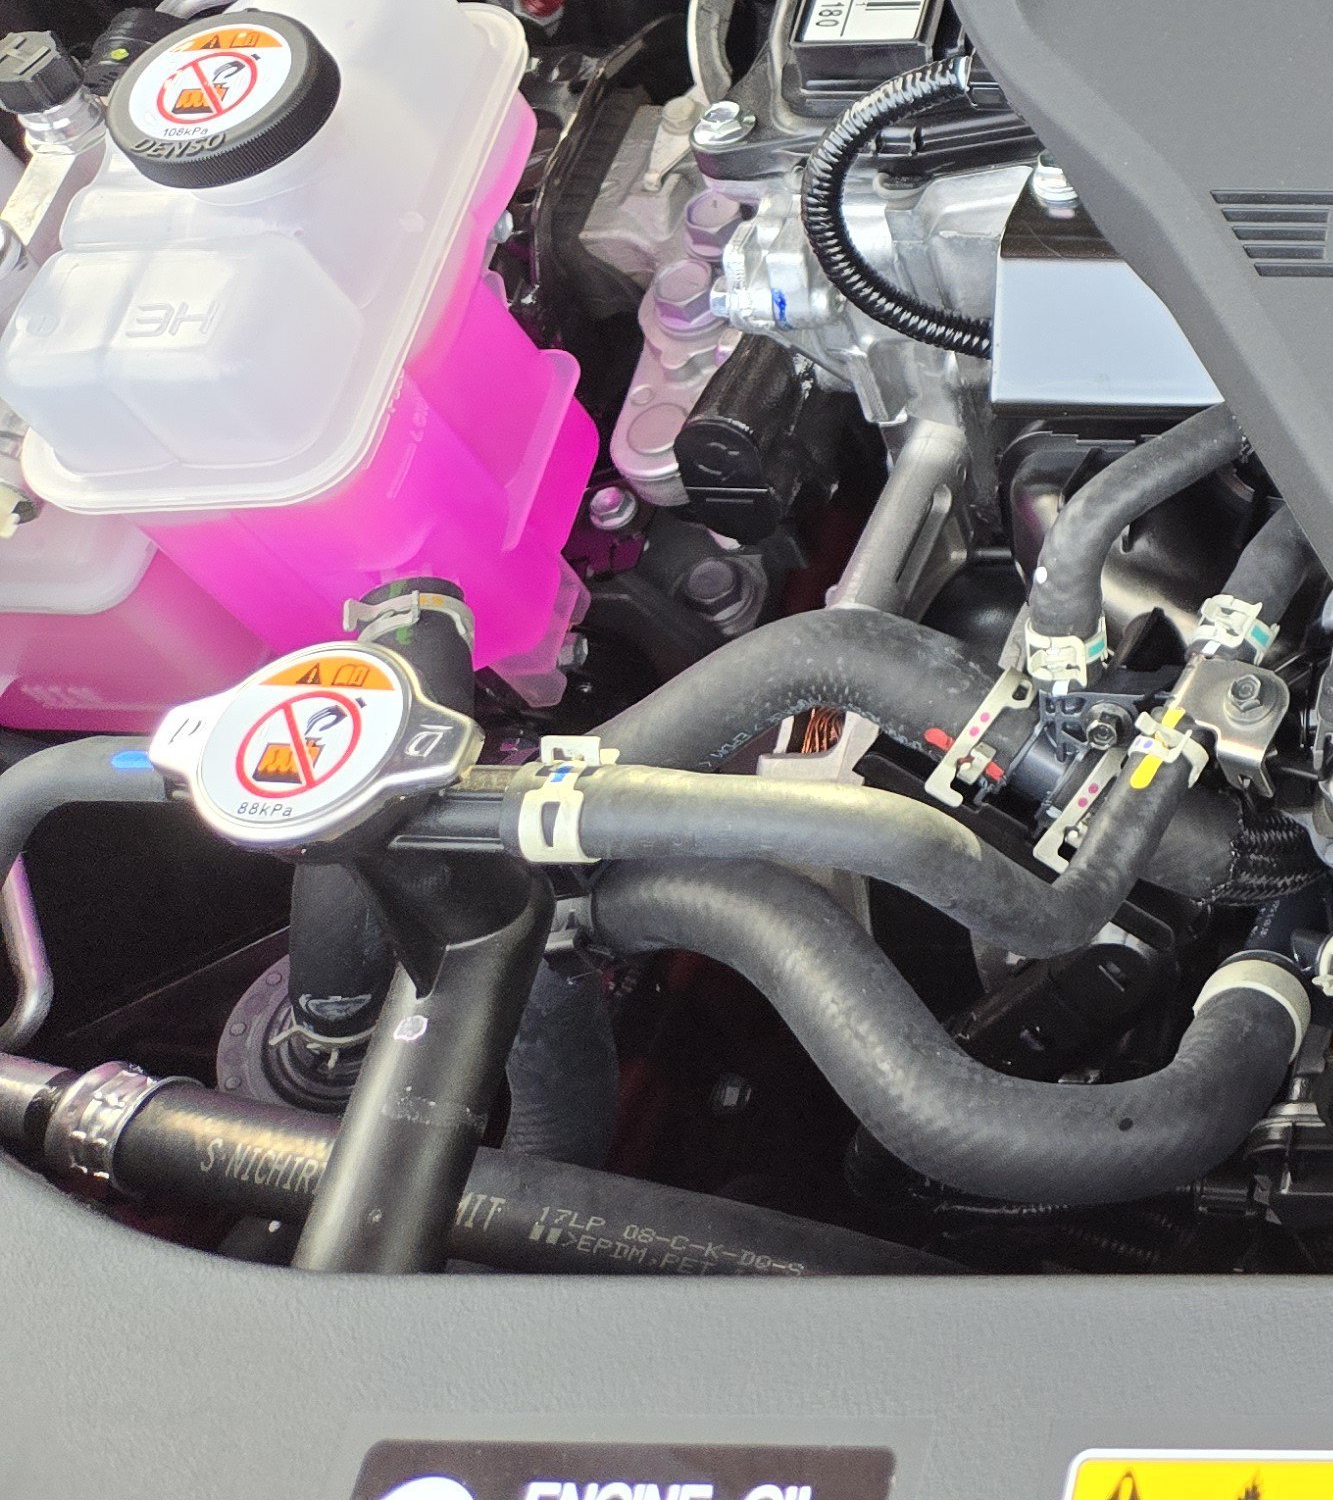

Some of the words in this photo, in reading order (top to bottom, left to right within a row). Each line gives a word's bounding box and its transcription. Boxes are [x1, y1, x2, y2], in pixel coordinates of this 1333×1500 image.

[815, 1, 846, 29] 180
[162, 125, 209, 138] 108kPa
[130, 132, 227, 160] DENSO
[237, 800, 293, 818] 88kPa
[539, 1205, 606, 1232] 17LP
